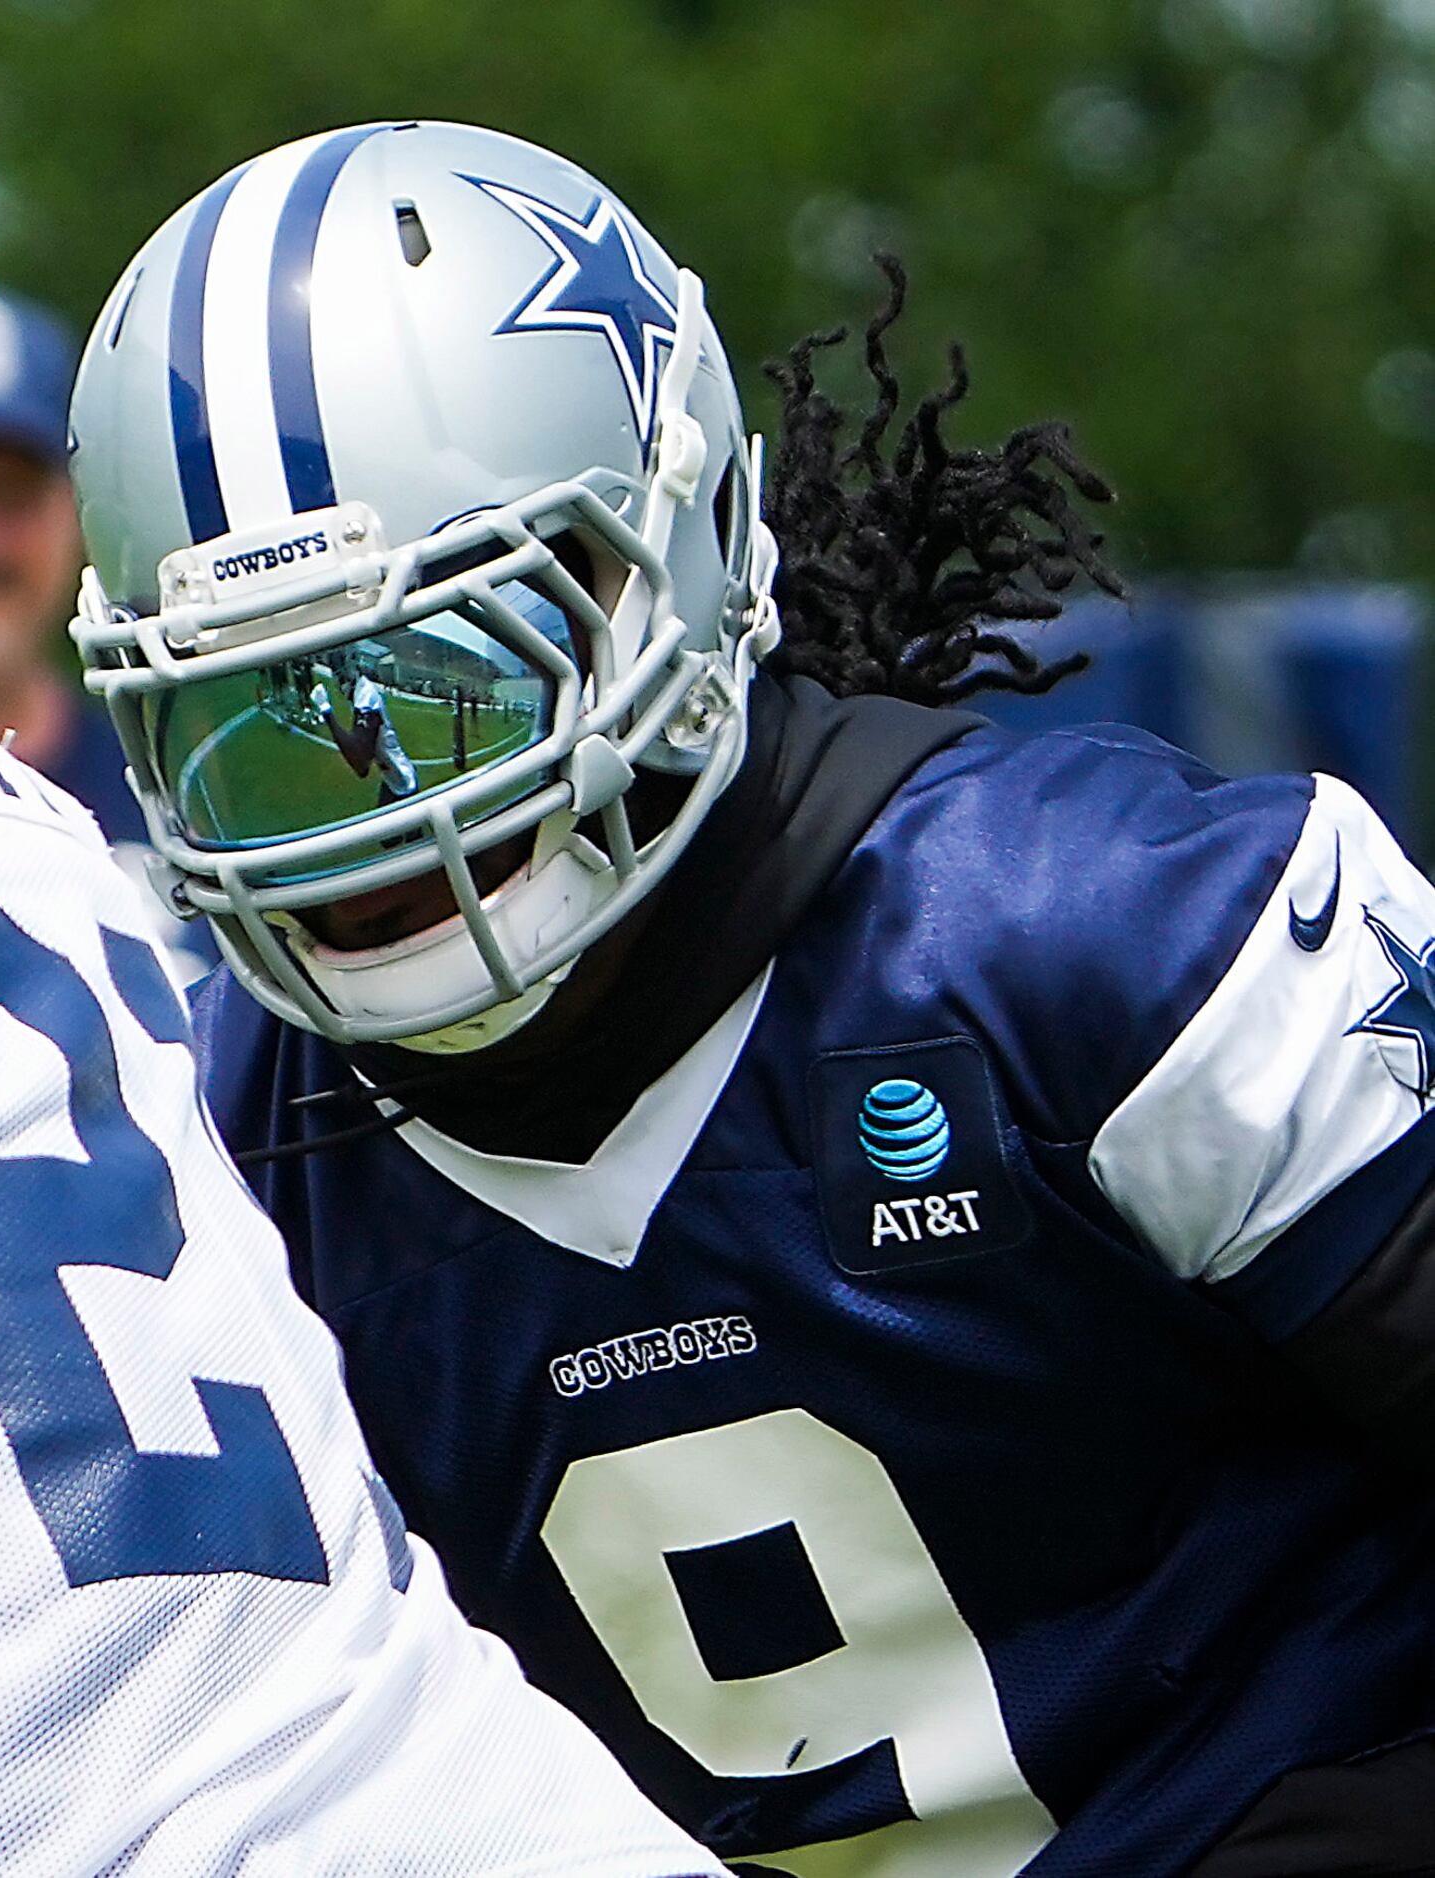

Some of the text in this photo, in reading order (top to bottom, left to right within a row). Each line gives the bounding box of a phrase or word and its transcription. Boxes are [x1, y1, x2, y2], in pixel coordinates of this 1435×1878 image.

[213, 531, 328, 580] COWBOYS
[872, 1190, 980, 1247] AT&T
[550, 1316, 757, 1397] COWBOYS
[540, 1407, 1060, 1878] 9
